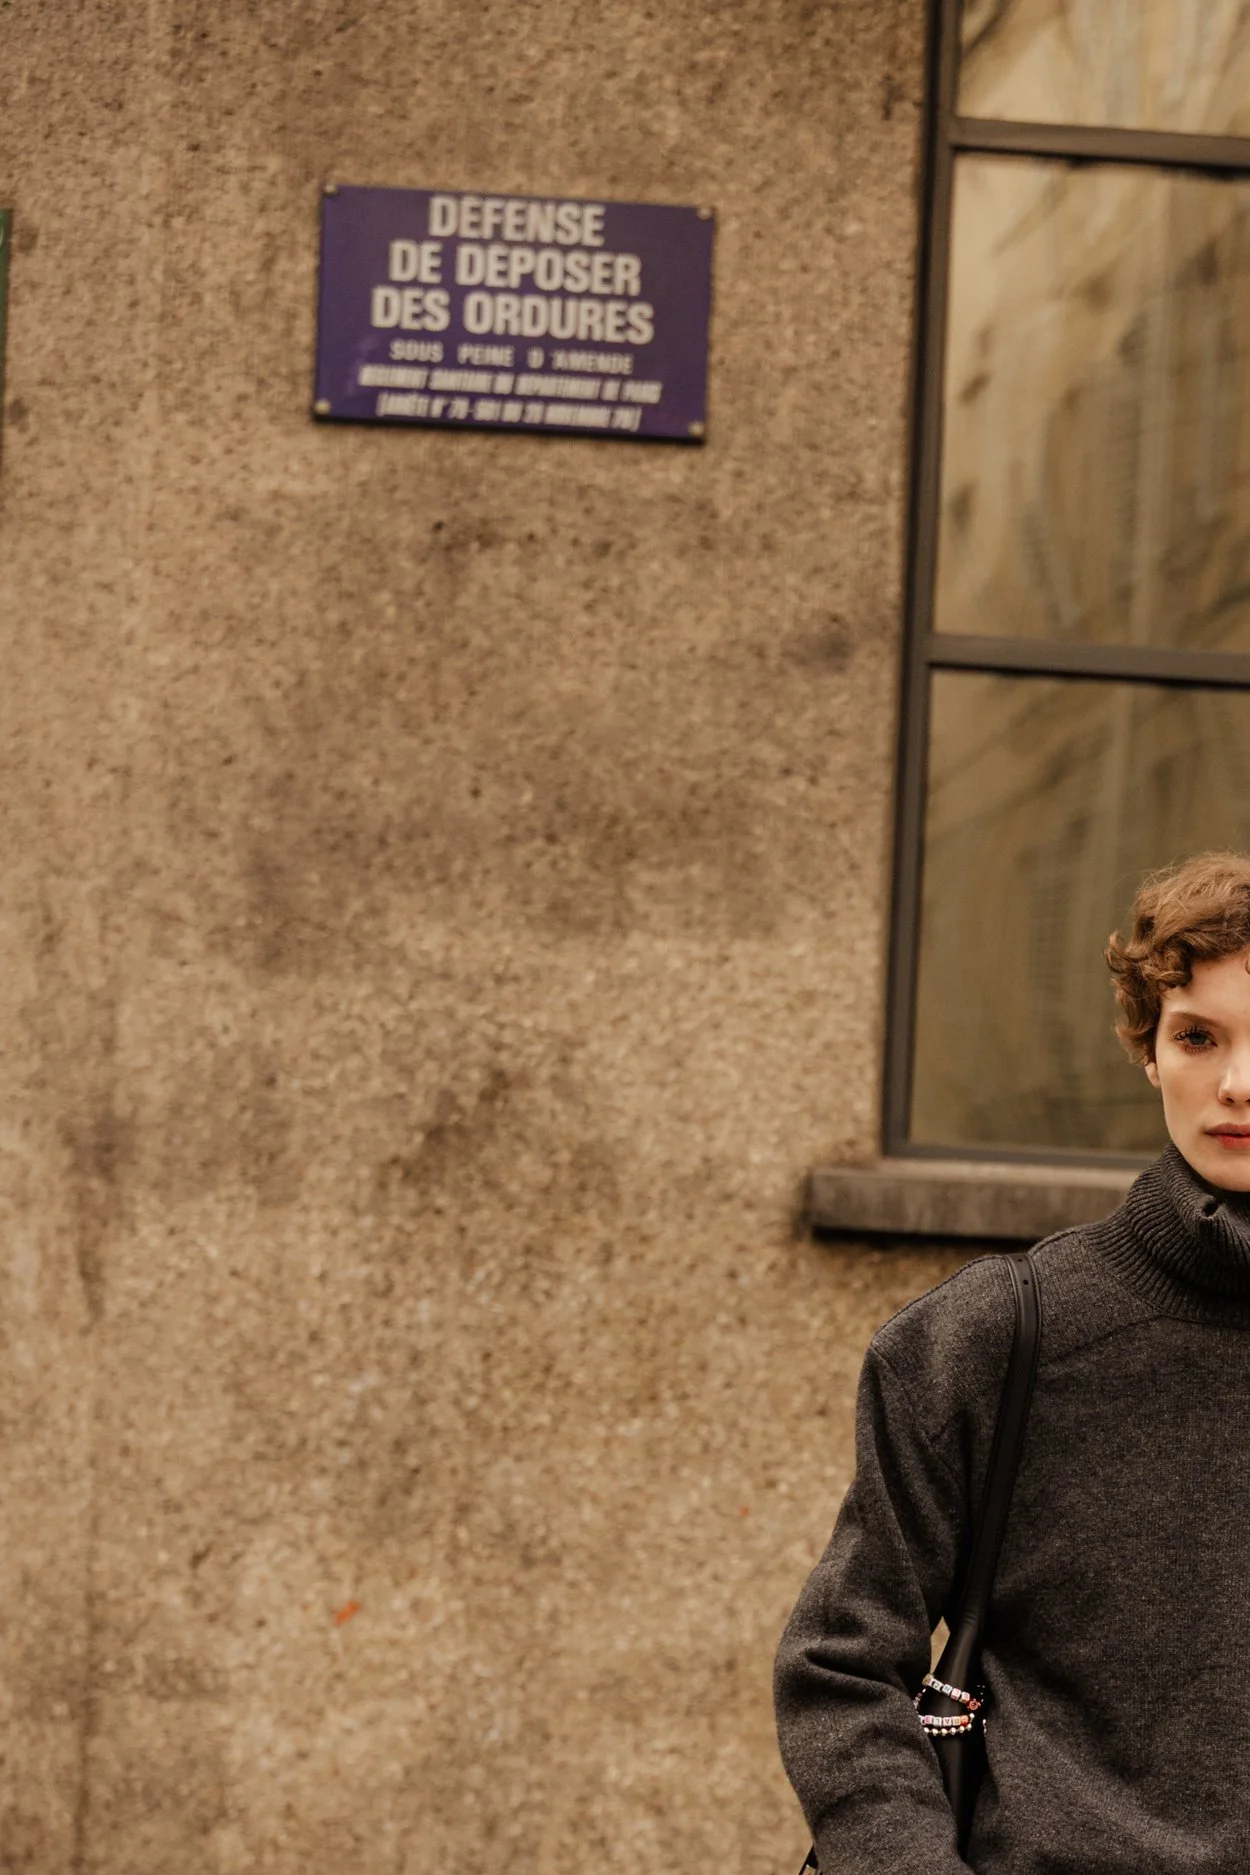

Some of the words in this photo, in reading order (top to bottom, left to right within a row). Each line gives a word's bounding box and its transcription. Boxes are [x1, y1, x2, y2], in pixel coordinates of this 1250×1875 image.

[388, 239, 443, 283] DE
[370, 286, 451, 331] DES
[462, 290, 655, 344] ORDURES
[388, 338, 444, 363] SOUS
[457, 343, 515, 368] PEINE
